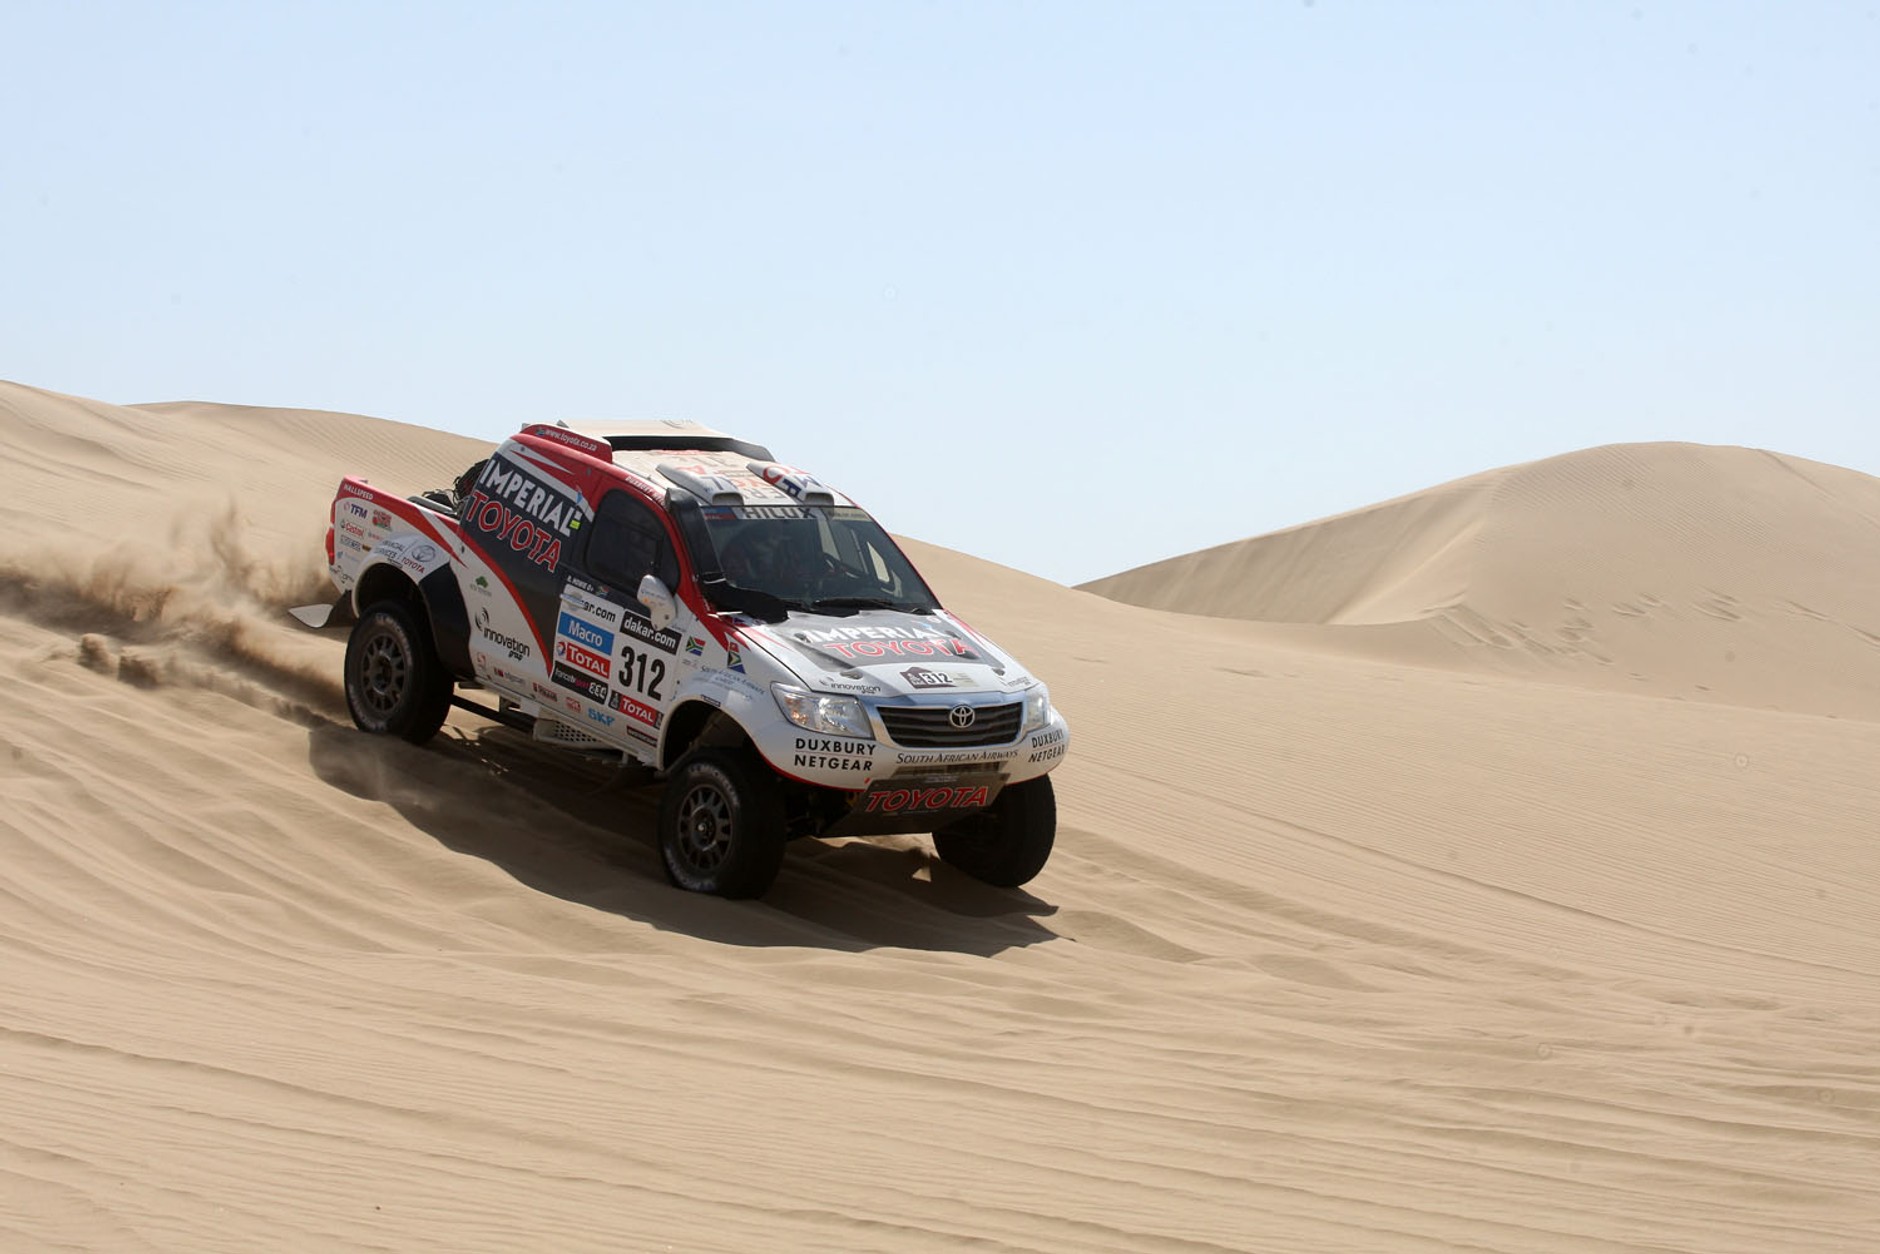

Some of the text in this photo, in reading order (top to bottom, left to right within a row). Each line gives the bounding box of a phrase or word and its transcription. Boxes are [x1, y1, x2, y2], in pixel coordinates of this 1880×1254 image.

[545, 428, 598, 452] www.toyota.co.za
[480, 459, 571, 537] IMPERIAL
[351, 503, 368, 519] TFM
[744, 507, 817, 519] HILUX
[466, 490, 561, 573] TOYOTA
[401, 556, 425, 574] TOYOTA
[483, 627, 530, 657] innovation
[568, 621, 603, 647] Macro
[624, 617, 676, 648] dakar.com
[806, 626, 951, 643] IMPERIAL
[823, 638, 981, 659] TOYOTA
[568, 645, 608, 676] TOTAL
[618, 646, 665, 701] 312
[922, 672, 953, 686] 312
[830, 683, 881, 692] innovation
[623, 698, 654, 723] TOTAL
[795, 738, 876, 756] DUXBURY
[1031, 729, 1064, 749] DUXBURY
[794, 755, 873, 772] NETGEAR
[896, 750, 1019, 764] SOUTH AFRICAN AIRWAYS
[1028, 745, 1065, 763] NETGEAR
[865, 785, 989, 813] TOYOTA
